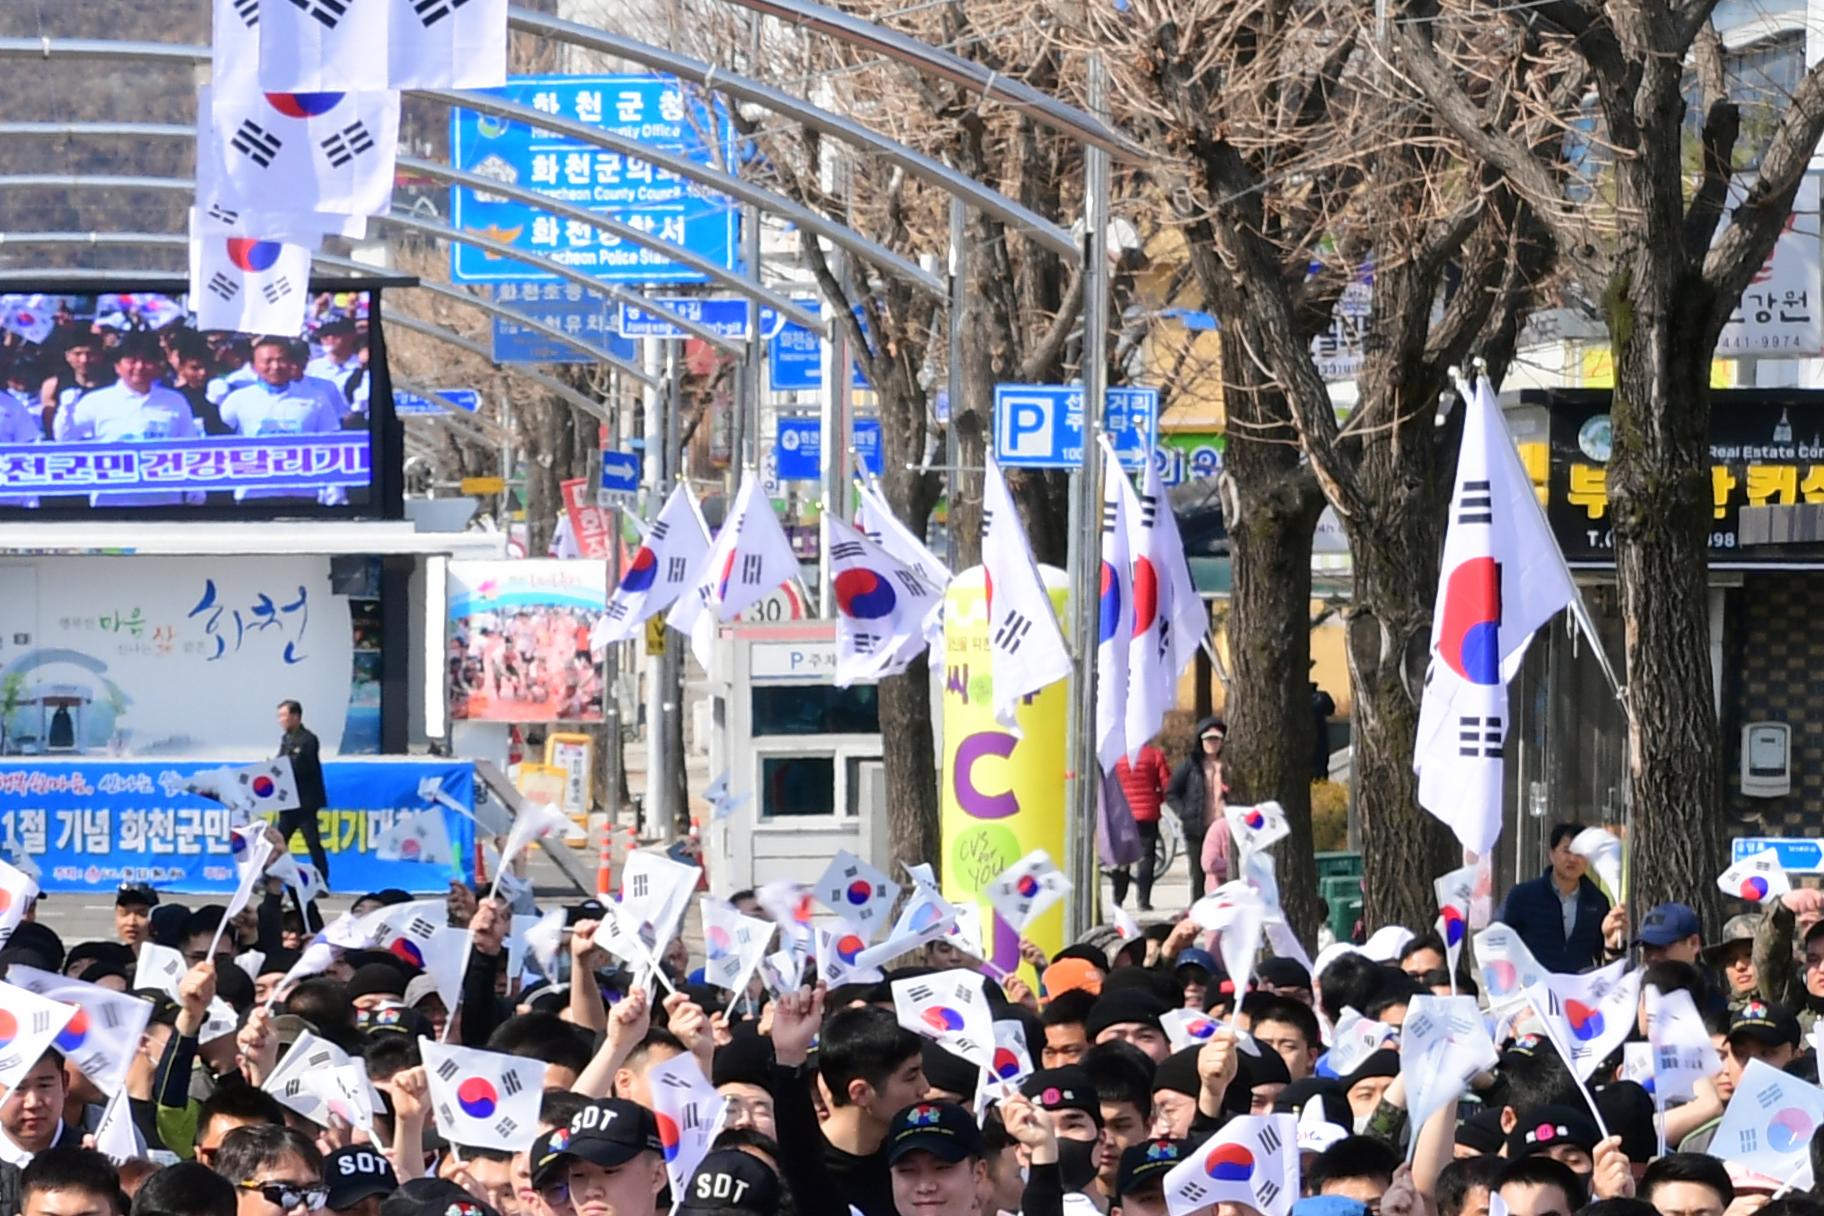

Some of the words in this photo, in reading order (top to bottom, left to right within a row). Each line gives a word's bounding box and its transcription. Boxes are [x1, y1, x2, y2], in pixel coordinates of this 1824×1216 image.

[532, 90, 686, 122] 화천군청
[593, 187, 635, 203] County
[1064, 394, 1151, 412] 선거리
[1008, 402, 1045, 450] P
[141, 445, 370, 480] 건강달리기
[1742, 445, 1794, 460] Estate
[749, 597, 782, 622] 30
[55, 807, 112, 855] 기념
[695, 1172, 750, 1203] SDT
